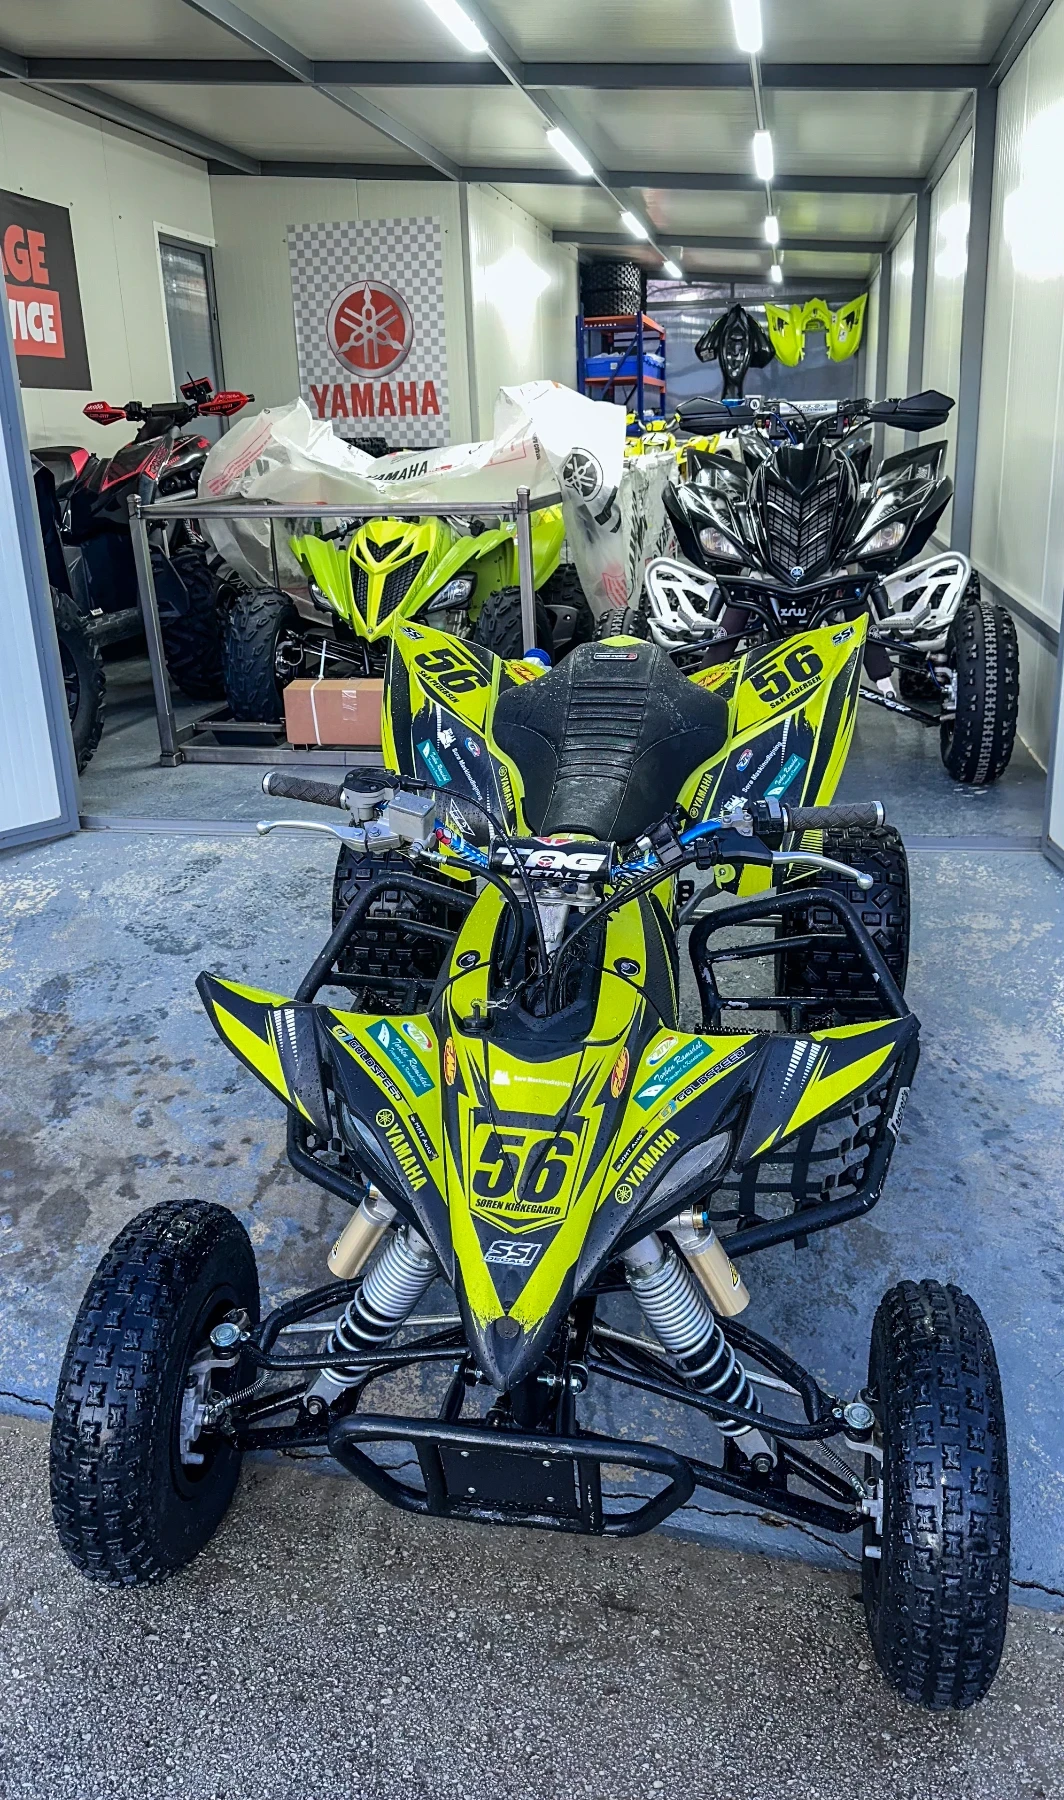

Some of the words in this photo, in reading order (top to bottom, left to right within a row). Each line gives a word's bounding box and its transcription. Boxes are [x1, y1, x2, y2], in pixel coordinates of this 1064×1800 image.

[310, 380, 441, 418] YAMAHA
[832, 627, 855, 643] SSI
[414, 648, 488, 694] 56
[750, 644, 824, 703] 56
[428, 678, 460, 704] PEDERSEN
[769, 695, 786, 709] S&K
[785, 675, 822, 700] PEDERSEN
[751, 741, 783, 782] Maskinudlejning
[499, 774, 515, 812] YAMAHA
[695, 773, 714, 808] YAMAHA
[496, 847, 607, 872] TAG
[511, 868, 590, 881] METALS
[349, 1039, 403, 1102] GOLDSPEED
[391, 1038, 409, 1062] Torben
[406, 1055, 431, 1088] Ramsdal
[653, 1061, 676, 1082] Torben
[674, 1042, 703, 1065] Ramsdal
[676, 1048, 745, 1102] GOLDSPEED
[385, 1123, 428, 1192] YAMAHA
[414, 1122, 427, 1143] MMT
[422, 1141, 433, 1156] Auto
[619, 1147, 632, 1165] MMT
[631, 1132, 643, 1149] Auto
[625, 1128, 680, 1188] YAMAHA
[472, 1131, 574, 1203] 56
[475, 1198, 503, 1210] SØREN
[504, 1202, 561, 1215] KIRKEGAARD
[487, 1241, 540, 1260] SSI
